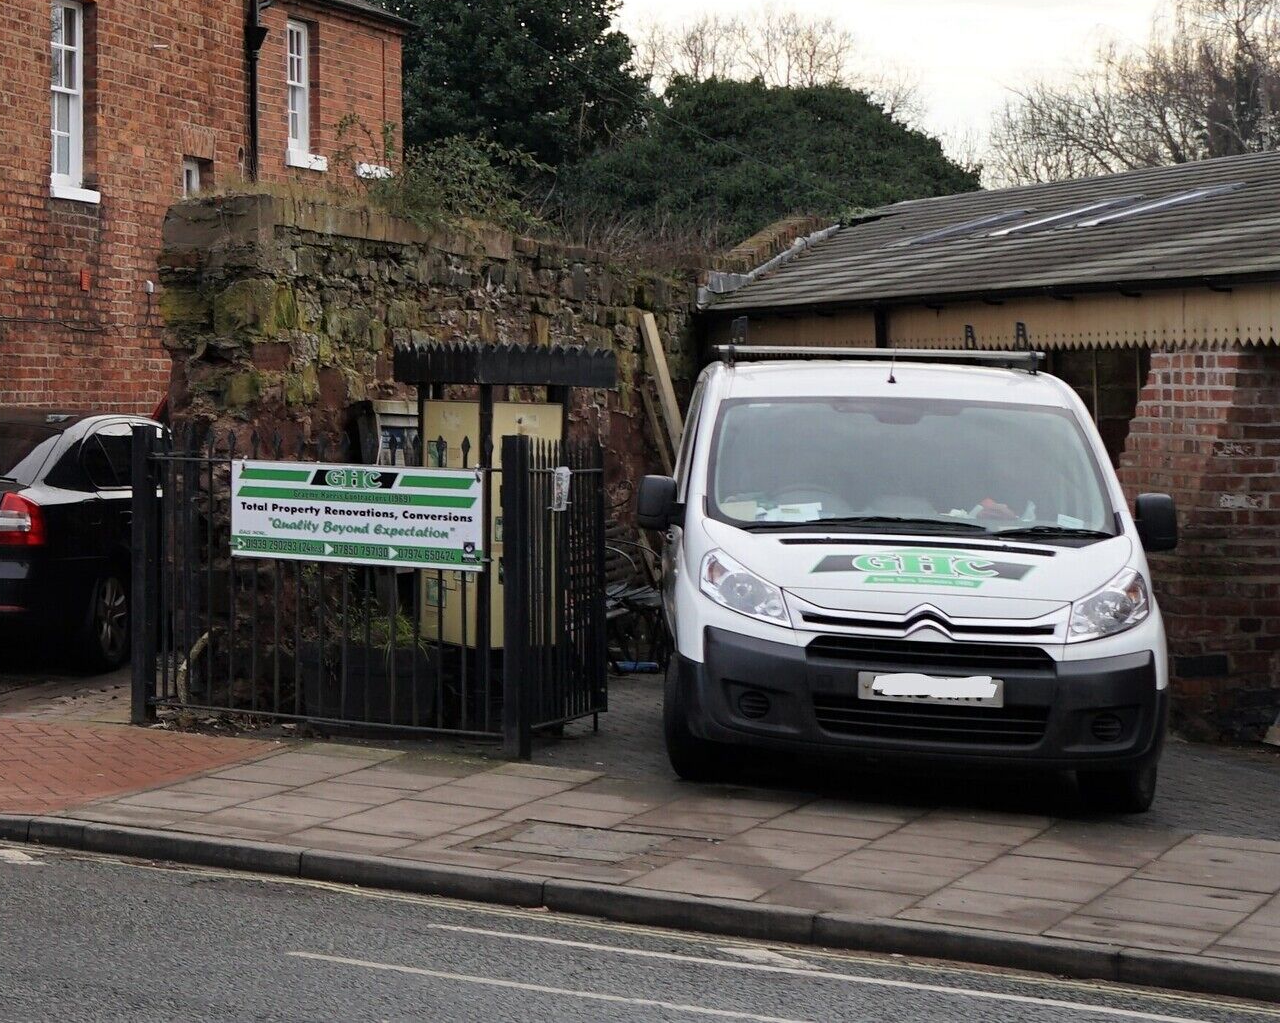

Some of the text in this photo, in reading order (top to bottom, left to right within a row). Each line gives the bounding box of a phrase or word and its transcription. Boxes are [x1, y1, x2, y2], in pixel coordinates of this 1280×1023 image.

[325, 468, 383, 490] GHC
[241, 501, 473, 523] Total Property Renovations, Conversions
[268, 517, 319, 533] "Quality
[323, 520, 370, 535] Beyond
[373, 523, 456, 539] Expectation"
[245, 539, 267, 549] 01939
[269, 540, 297, 551] 290293
[333, 543, 389, 555] 07850 797130
[852, 552, 1000, 578] GHC
